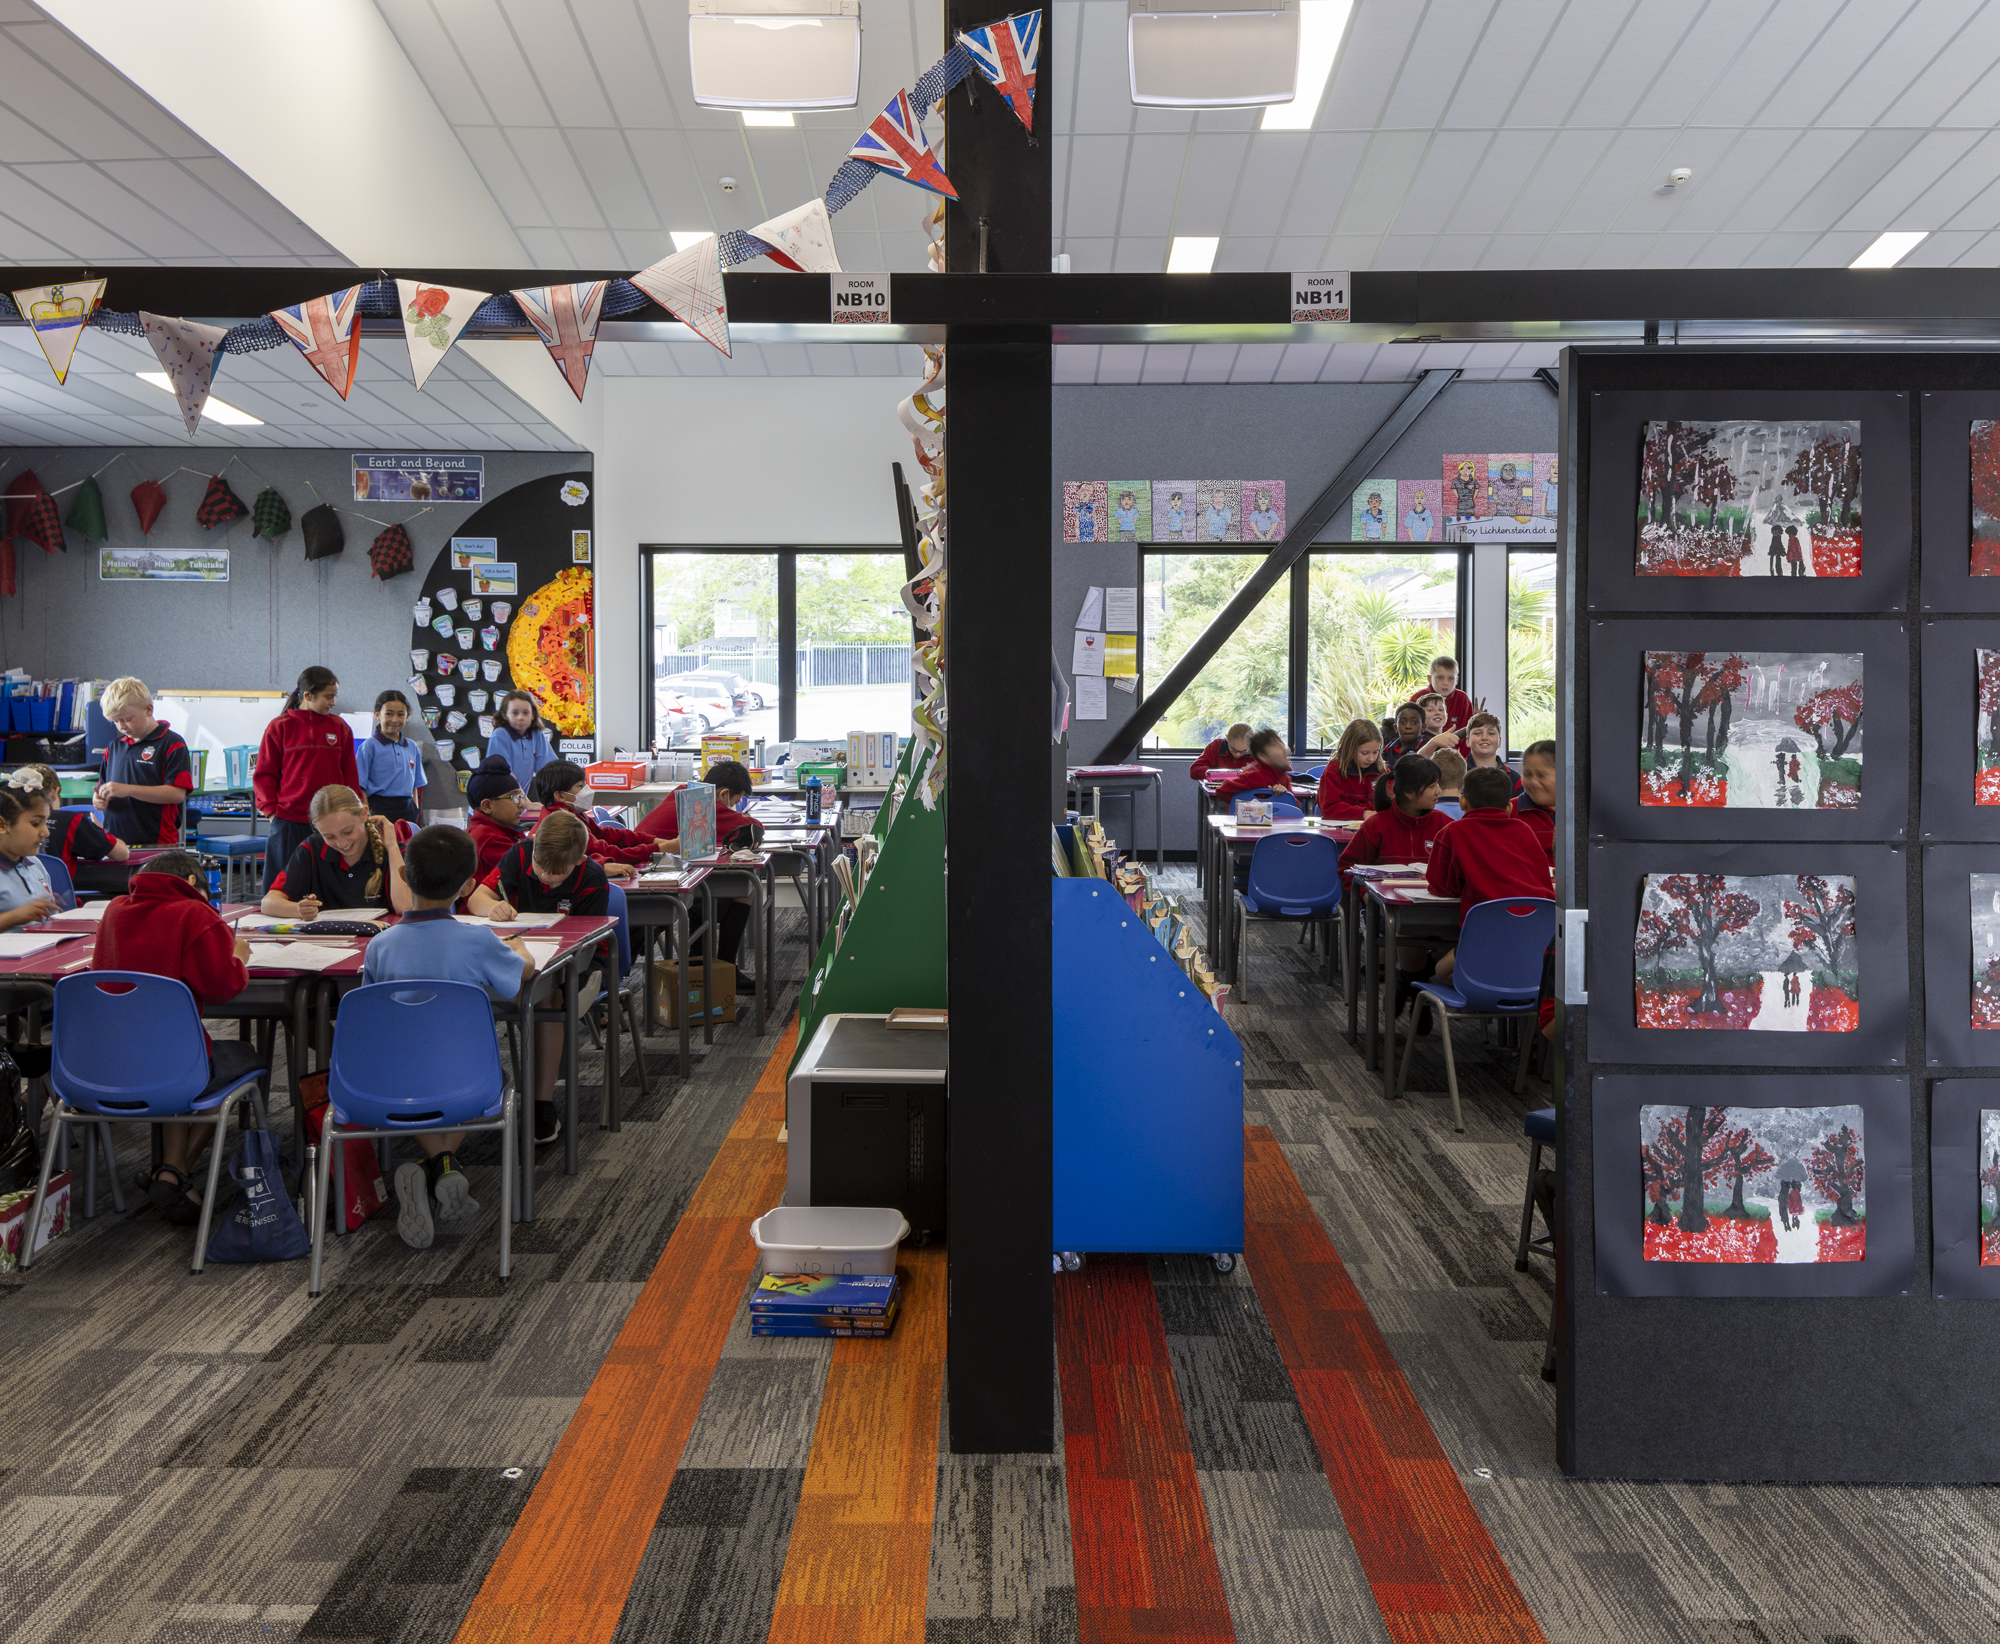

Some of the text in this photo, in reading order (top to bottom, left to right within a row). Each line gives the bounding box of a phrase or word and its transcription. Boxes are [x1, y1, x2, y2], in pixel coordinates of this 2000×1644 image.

[848, 280, 874, 288] ROOM
[1307, 278, 1334, 286] ROOM
[836, 292, 886, 306] NB10
[1295, 290, 1343, 304] NB11
[400, 457, 422, 468] and
[425, 457, 466, 470] Beyond
[1462, 526, 1477, 537] Roy
[1480, 526, 1531, 535] Lichtenstein
[1532, 526, 1547, 534] dot
[106, 560, 138, 568] Matariki
[189, 561, 224, 569] Tukutuku
[561, 742, 592, 750] COLLAB
